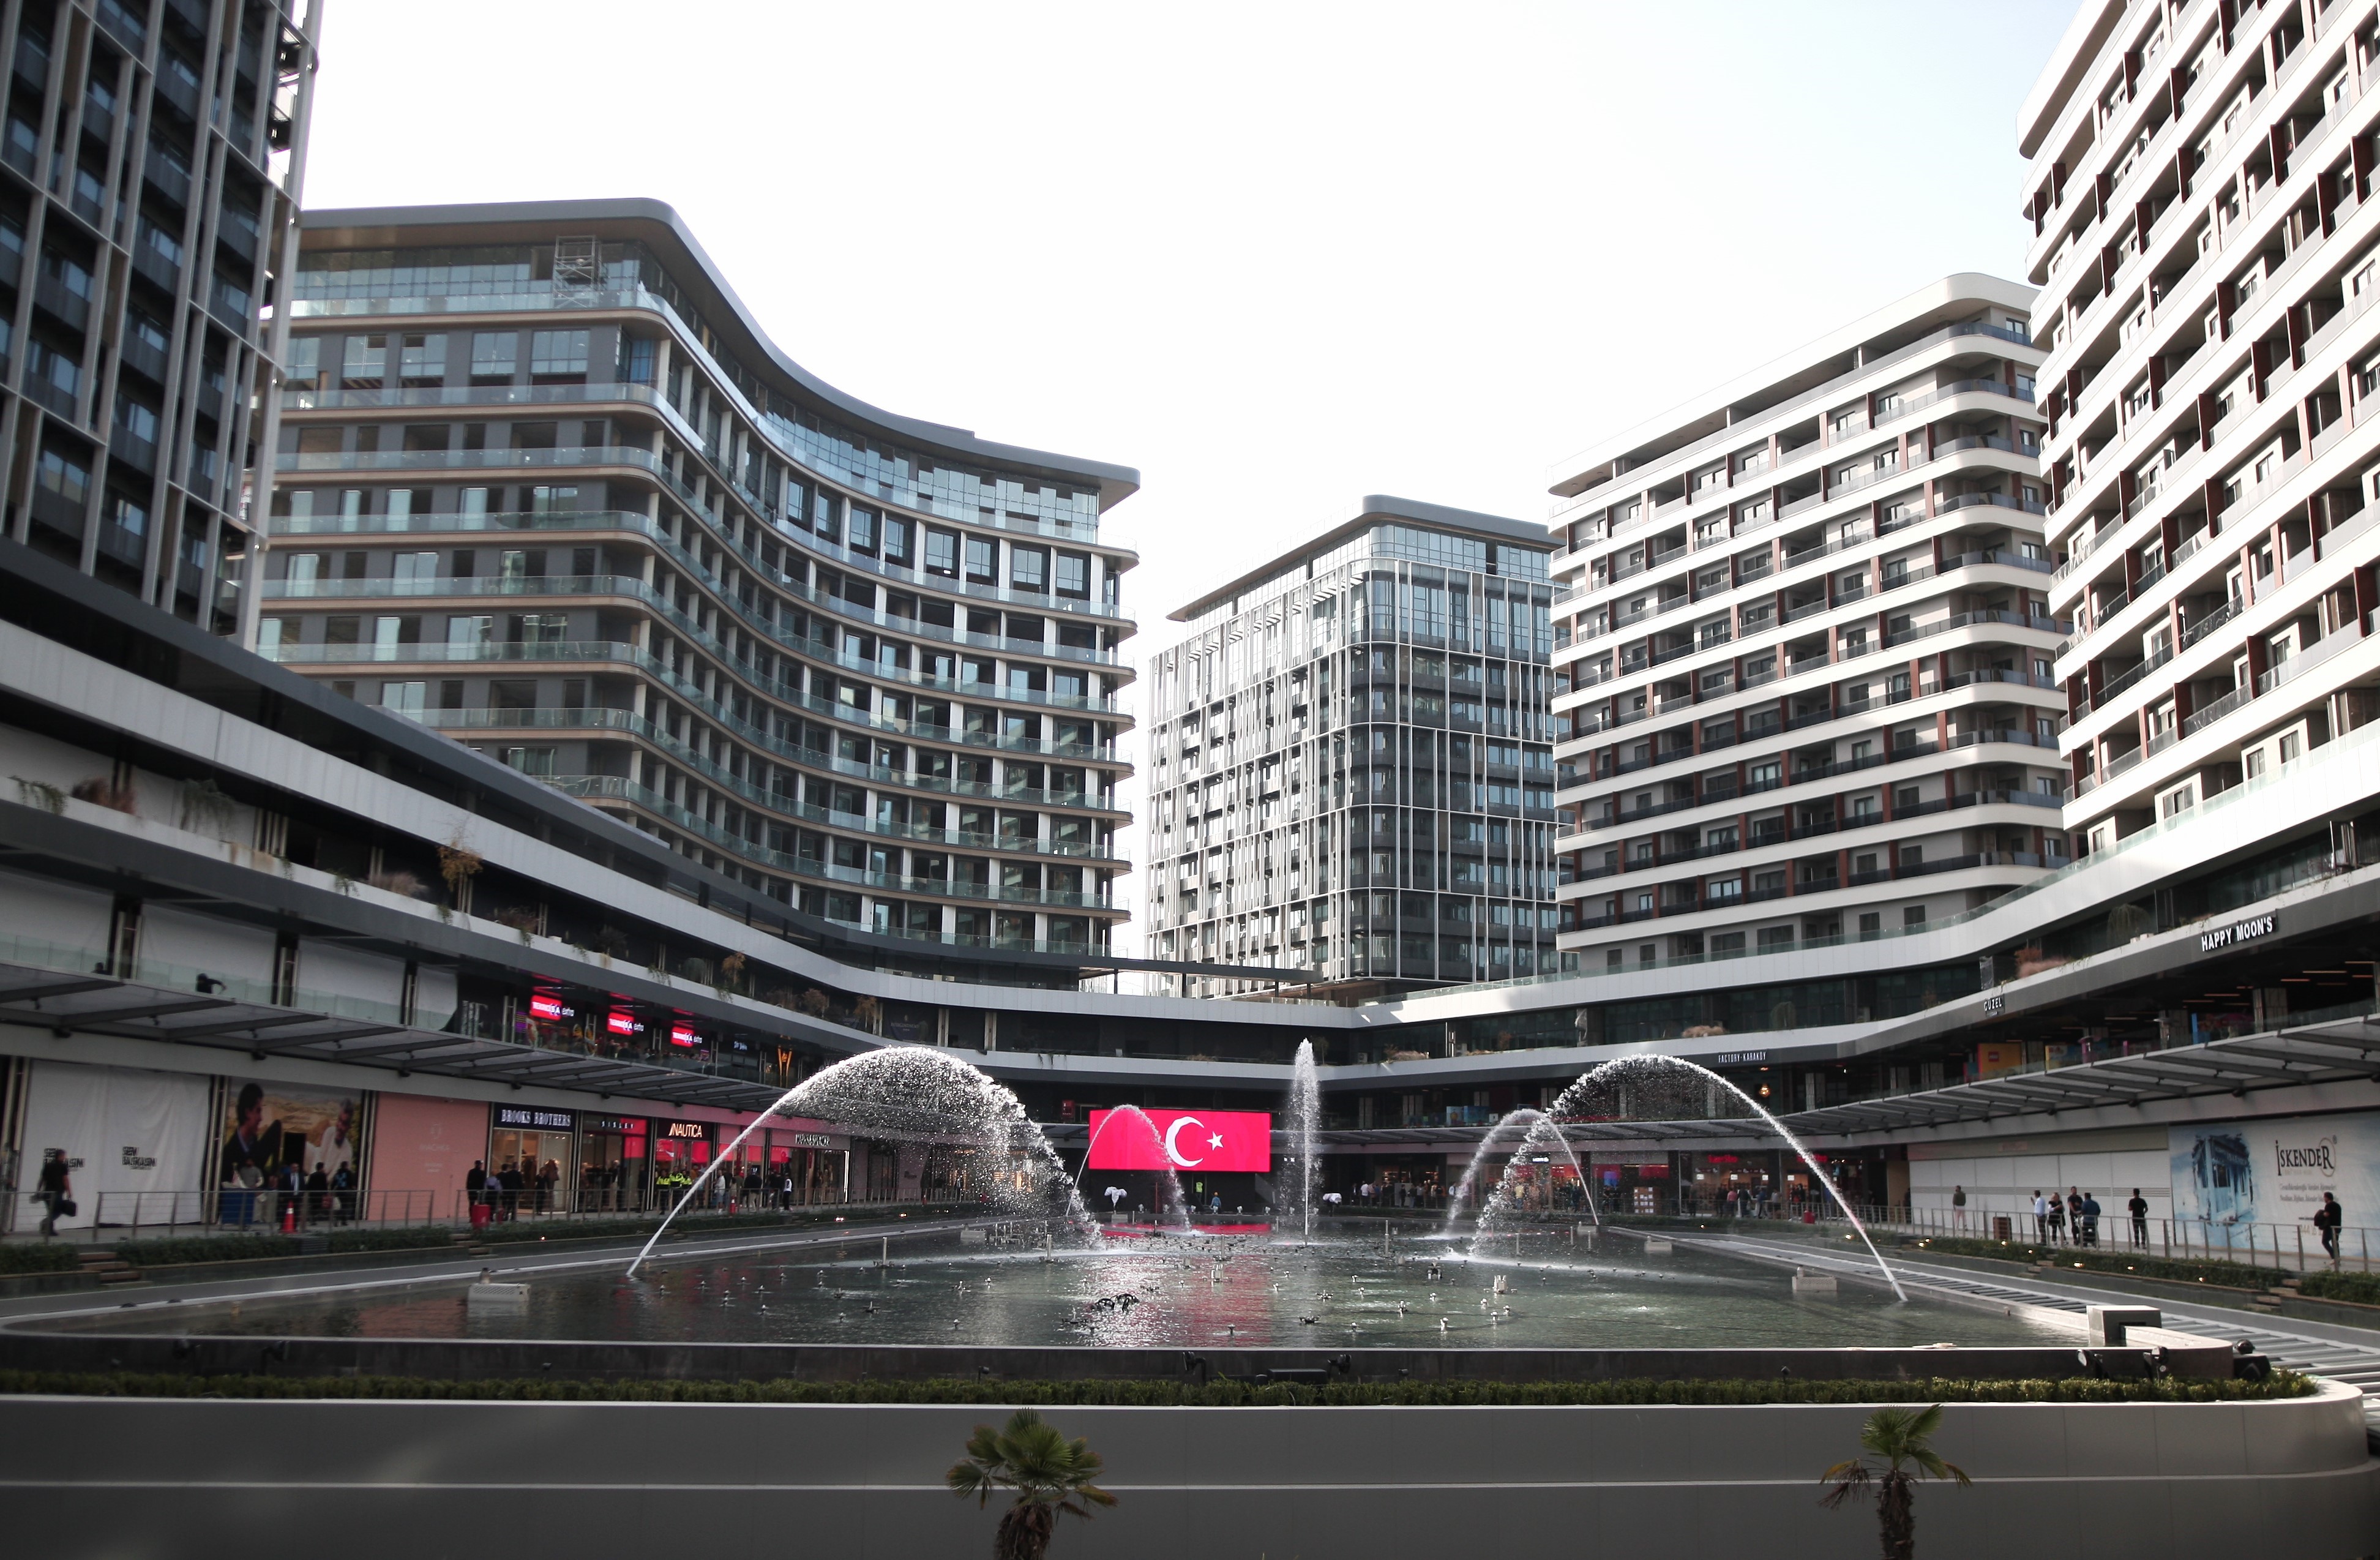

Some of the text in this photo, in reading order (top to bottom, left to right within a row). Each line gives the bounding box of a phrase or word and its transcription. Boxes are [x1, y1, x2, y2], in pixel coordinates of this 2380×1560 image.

[2201, 916, 2273, 952] HAPPY MOON'S
[501, 1109, 571, 1127] BROOKS BROTHERS
[601, 1120, 634, 1129] SISLEY
[668, 1123, 703, 1138] NAUTICA
